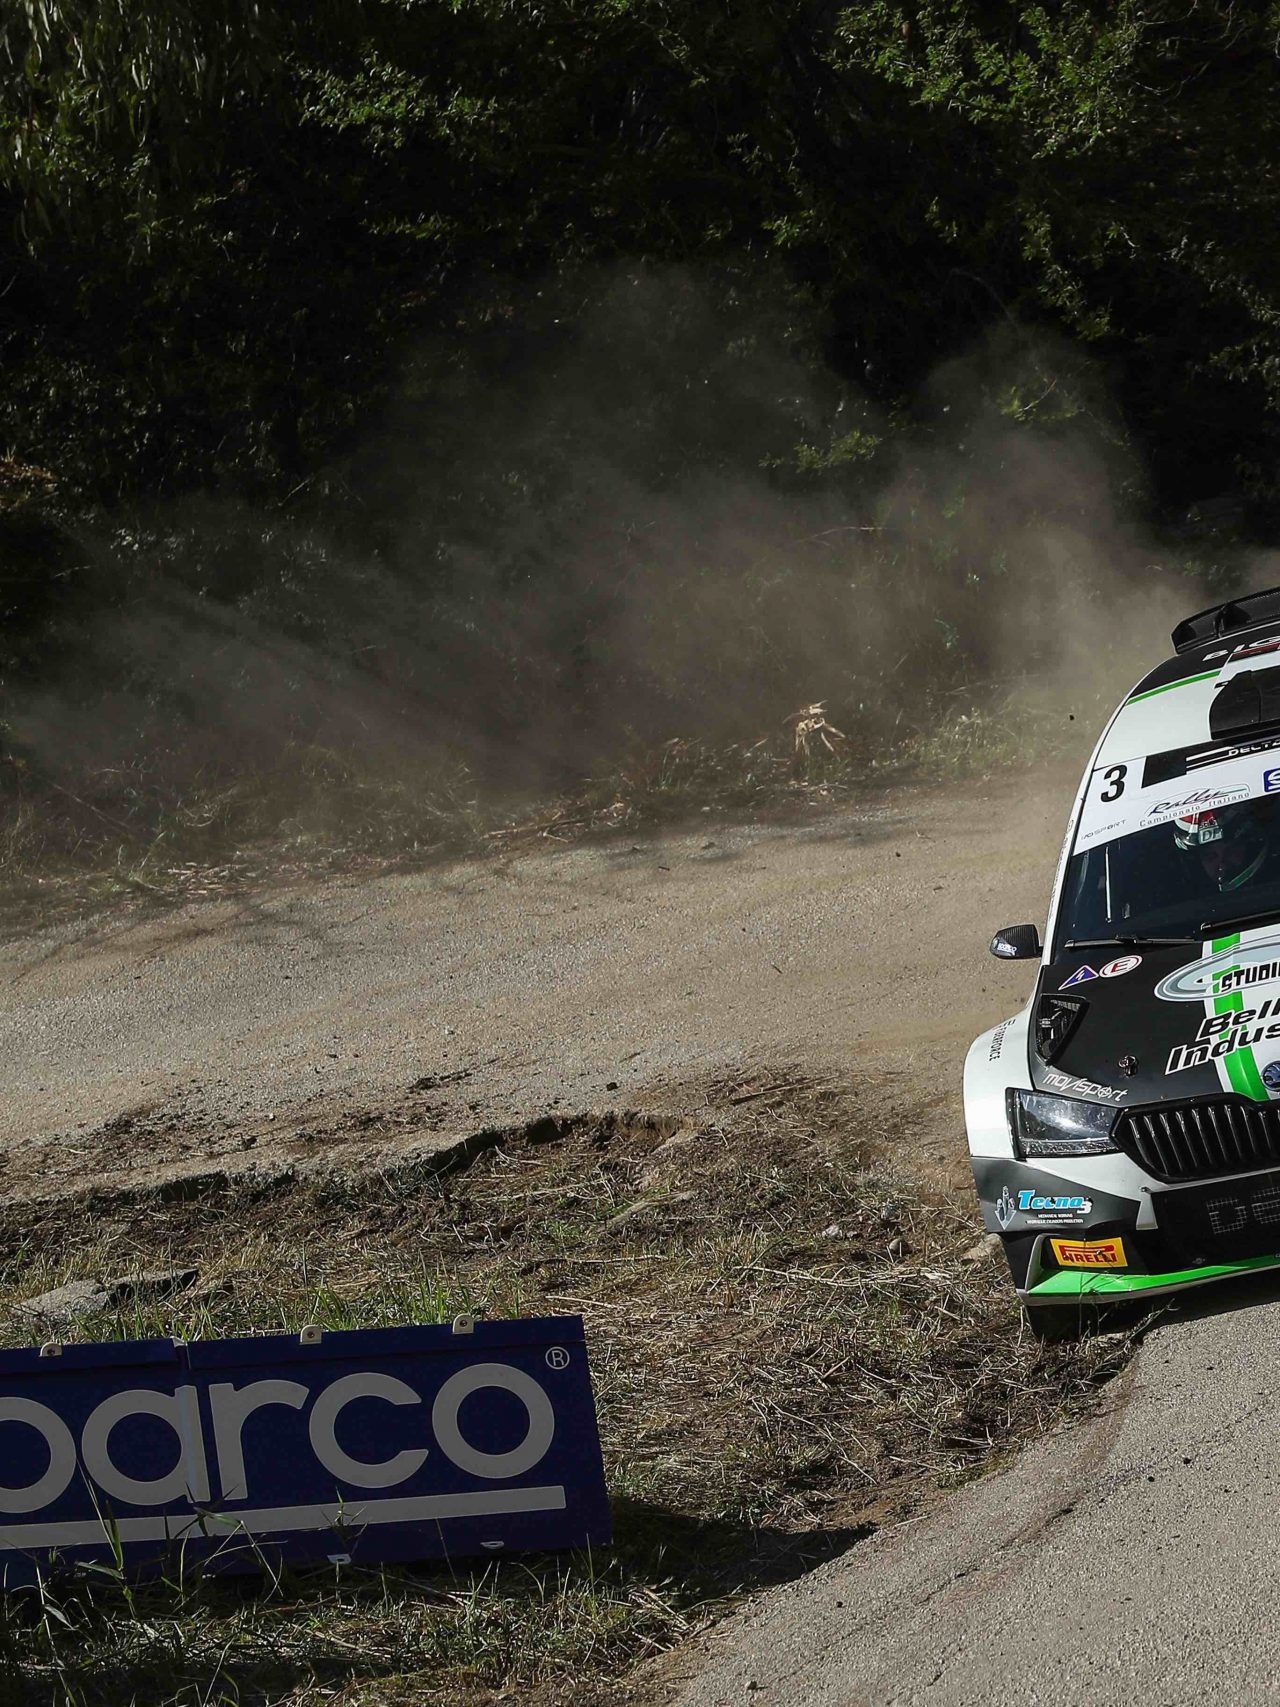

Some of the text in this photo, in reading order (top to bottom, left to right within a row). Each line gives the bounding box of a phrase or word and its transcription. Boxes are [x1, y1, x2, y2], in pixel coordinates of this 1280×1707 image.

[1100, 764, 1128, 803] 3
[1139, 805, 1201, 828] Campionato
[1208, 792, 1250, 808] Italiano
[1147, 788, 1229, 817] Rally
[1058, 1245, 1117, 1263] PIRELLI
